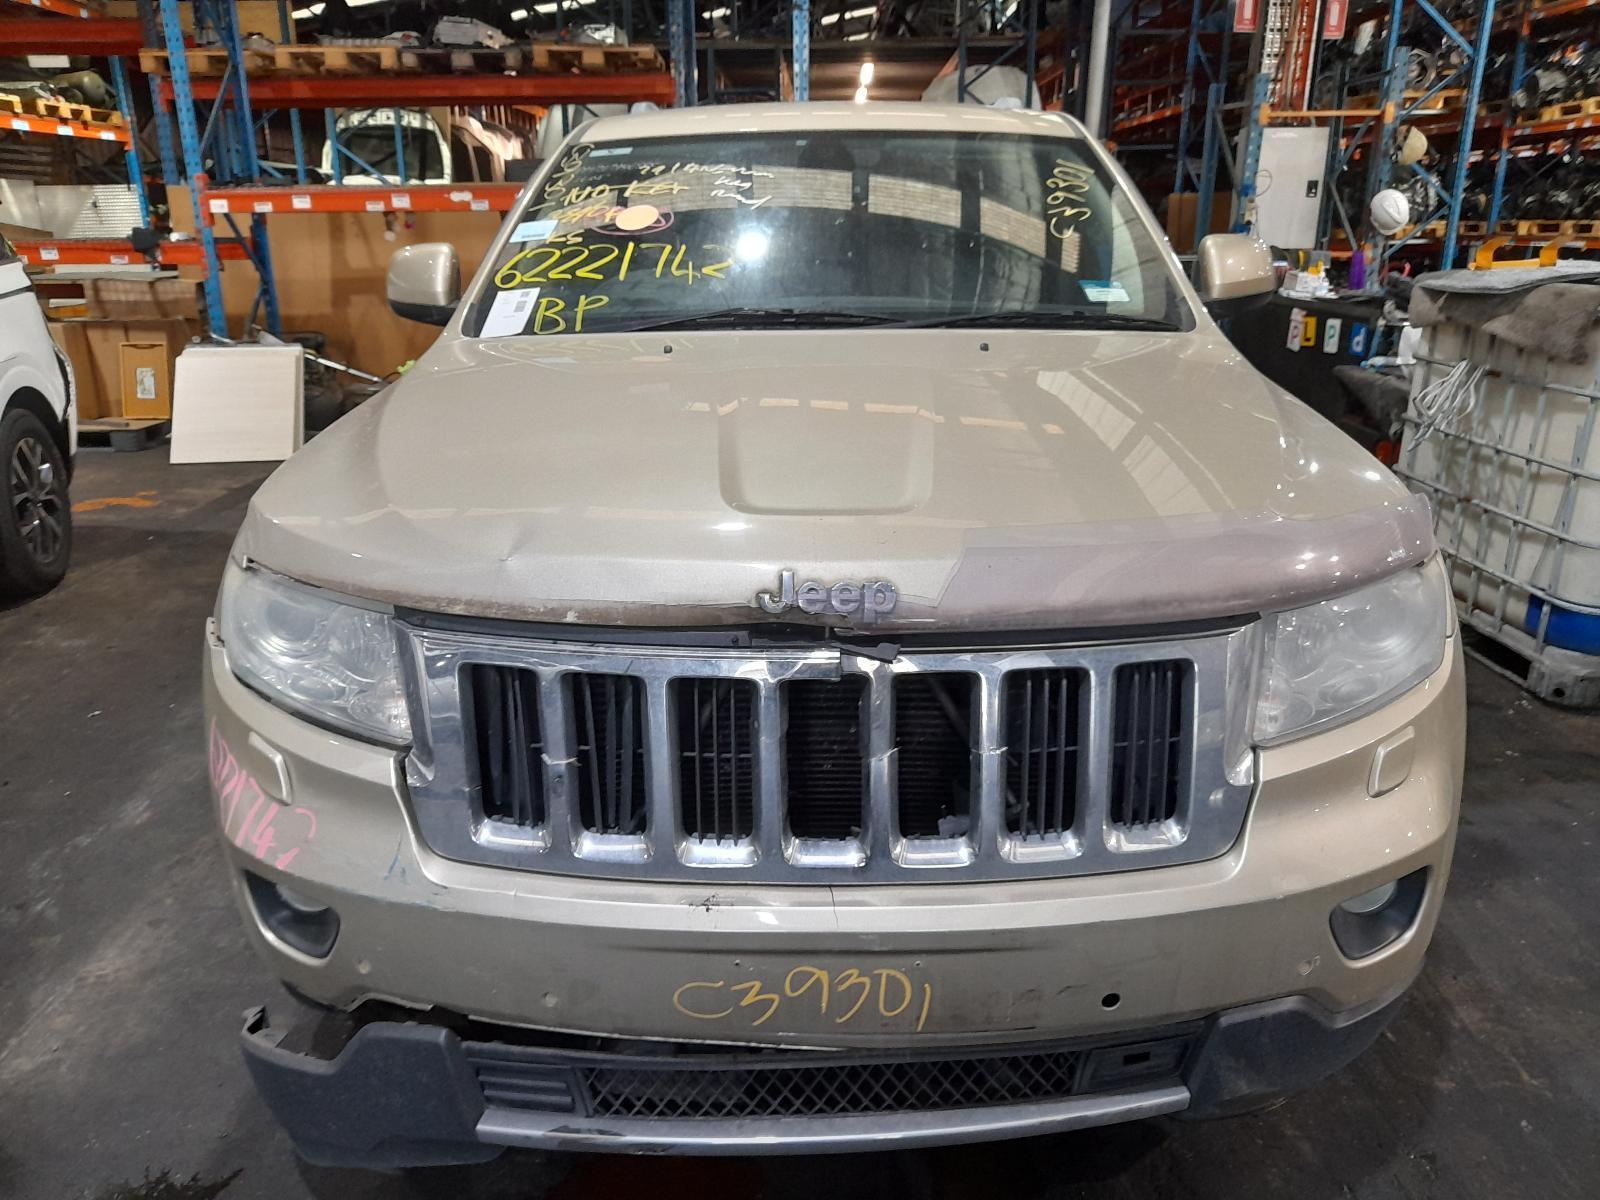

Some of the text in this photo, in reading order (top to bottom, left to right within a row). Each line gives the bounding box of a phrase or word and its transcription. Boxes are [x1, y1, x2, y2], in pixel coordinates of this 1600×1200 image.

[1046, 158, 1095, 239] C39301
[494, 241, 734, 288] 62221742
[756, 569, 897, 624] Jeep
[673, 966, 932, 1033] C39301
